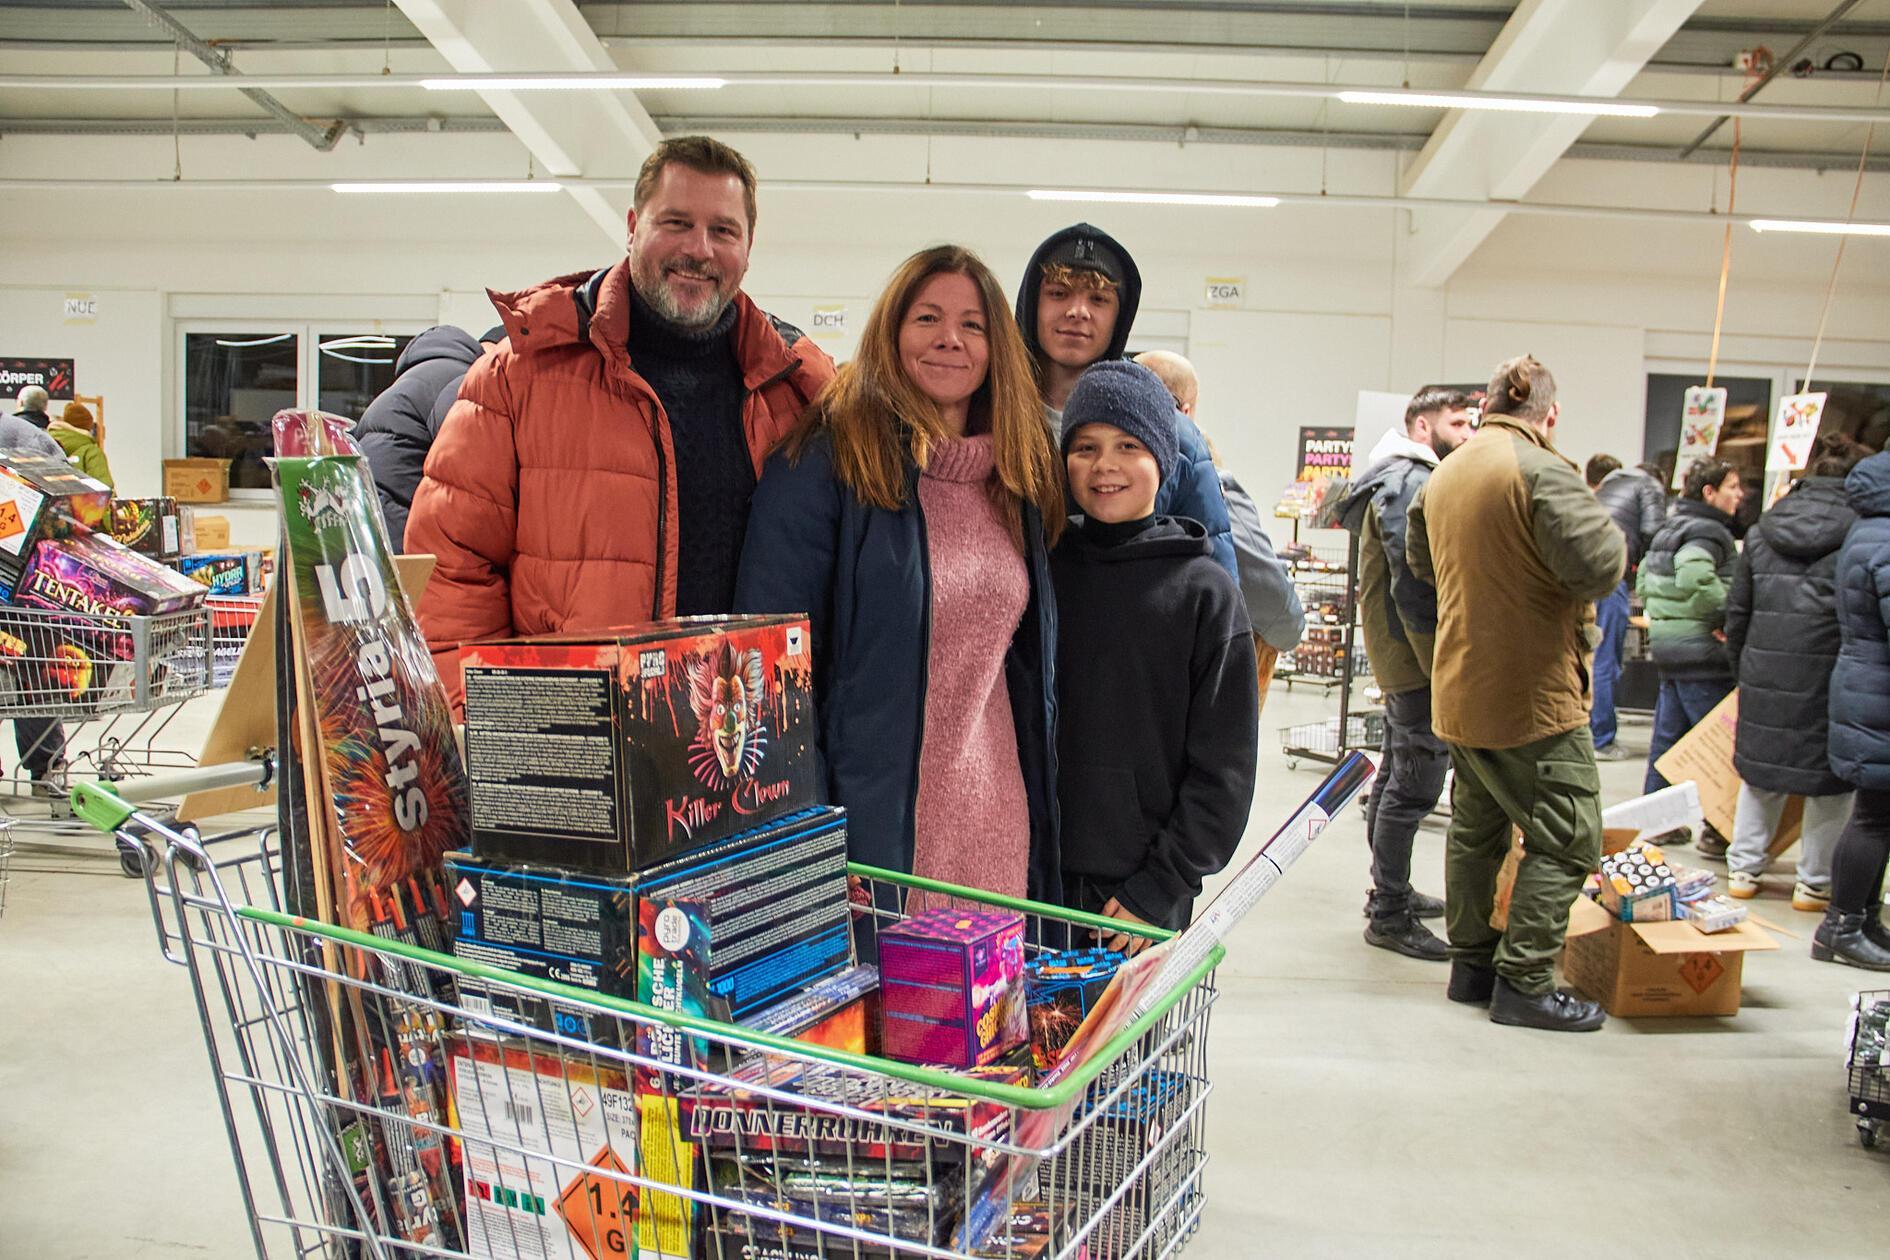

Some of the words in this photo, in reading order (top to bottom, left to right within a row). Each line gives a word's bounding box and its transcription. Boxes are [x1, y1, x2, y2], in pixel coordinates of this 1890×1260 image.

[1210, 286, 1239, 298] ZGA
[67, 301, 96, 314] NUE
[814, 314, 844, 327] DCH
[0, 369, 44, 385] ÖRPER
[212, 566, 244, 586] HYDRA
[31, 569, 122, 629] TENTAKEL
[315, 553, 385, 624] 5
[355, 640, 429, 832] Styria
[665, 795, 721, 842] Killer
[731, 777, 790, 814] Clown
[590, 1182, 637, 1223] 1.4
[606, 1229, 626, 1252] G
